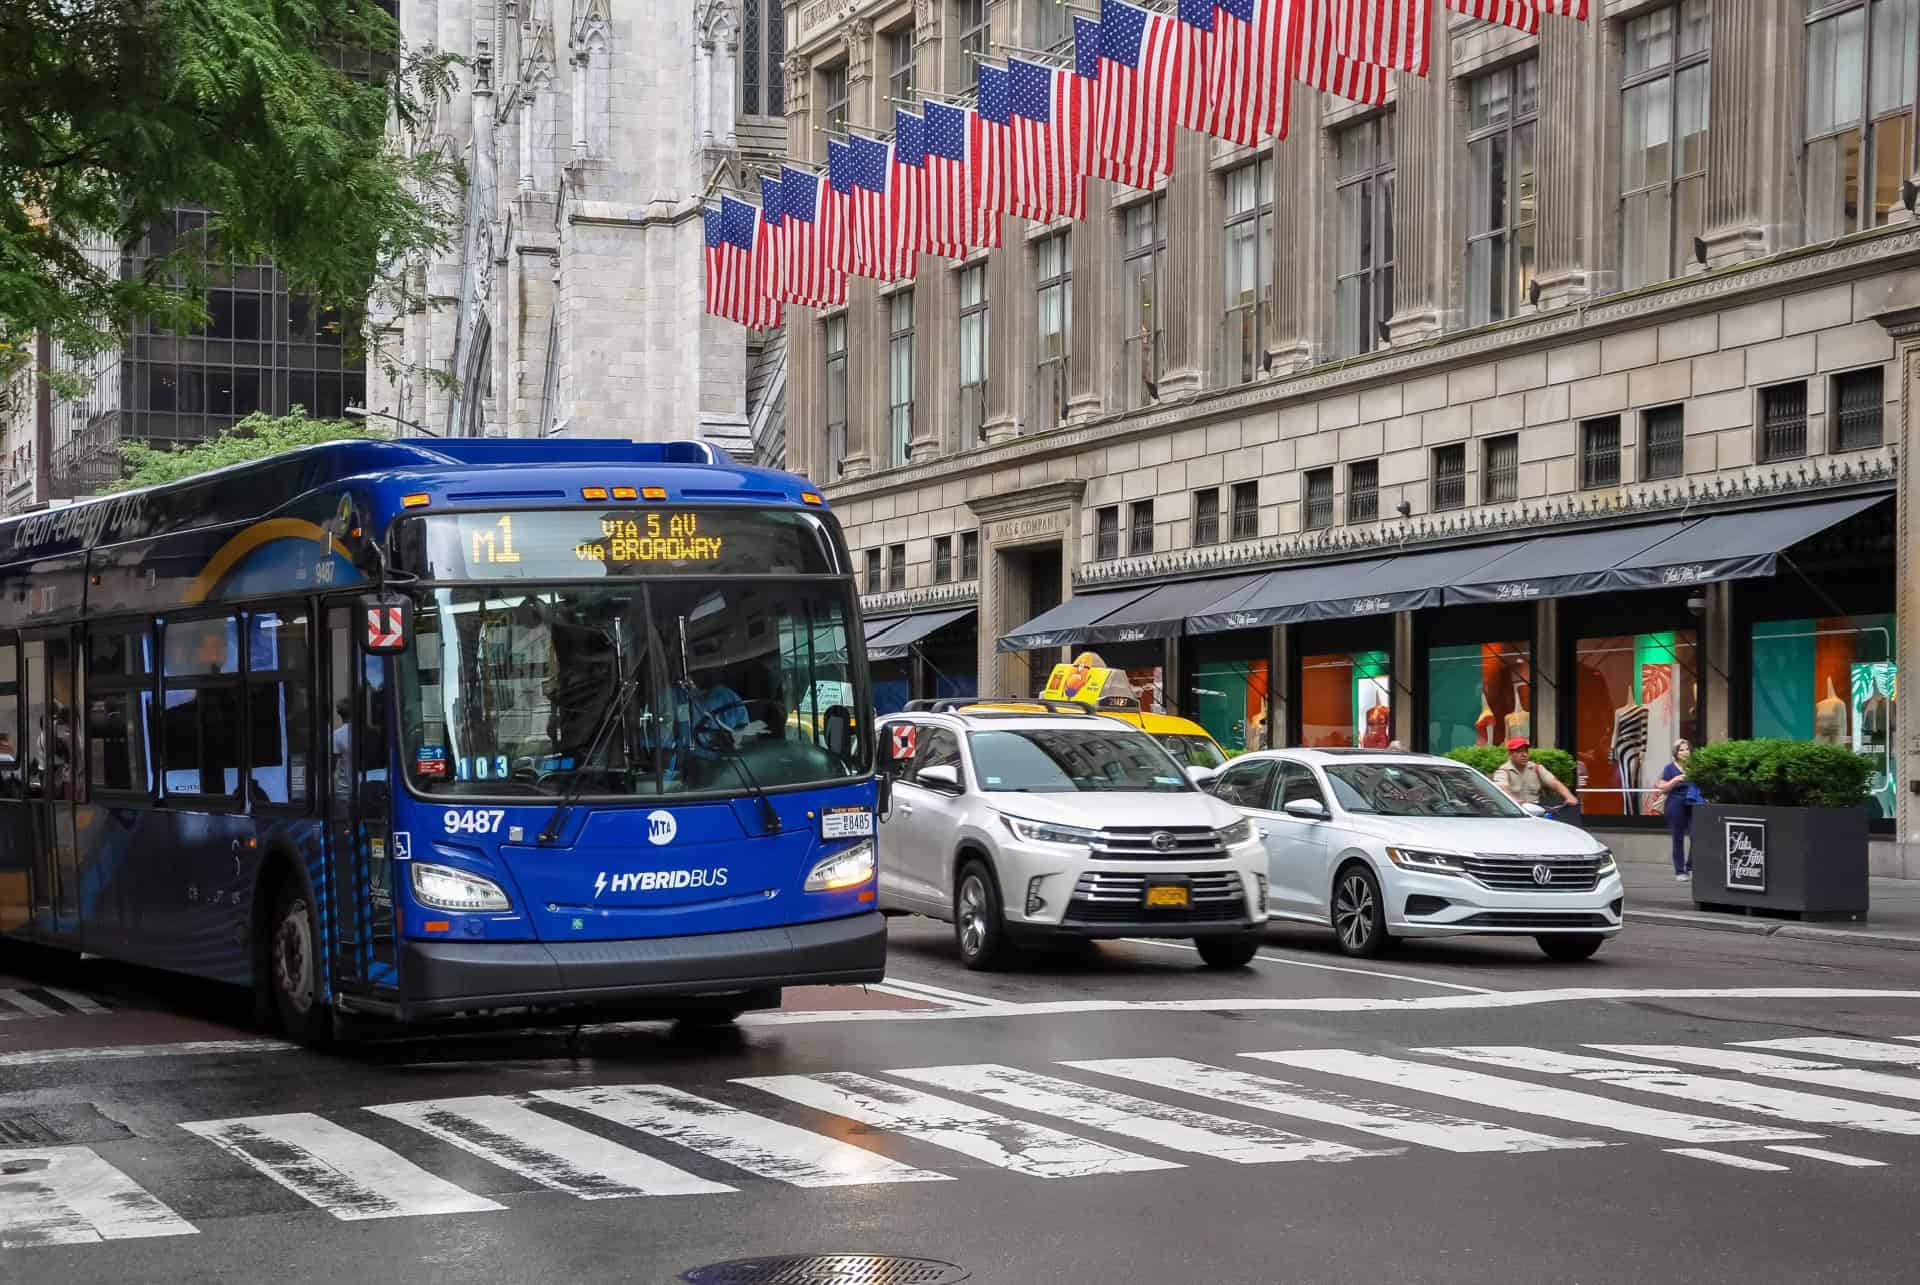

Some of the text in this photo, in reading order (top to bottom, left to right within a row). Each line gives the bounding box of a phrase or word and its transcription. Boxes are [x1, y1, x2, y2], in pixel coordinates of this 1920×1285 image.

[601, 513, 697, 538] VIA 5 AV
[472, 515, 520, 563] M1
[611, 537, 722, 561] BROADWAY
[443, 809, 505, 834] 9487
[1729, 831, 1752, 854] Saks
